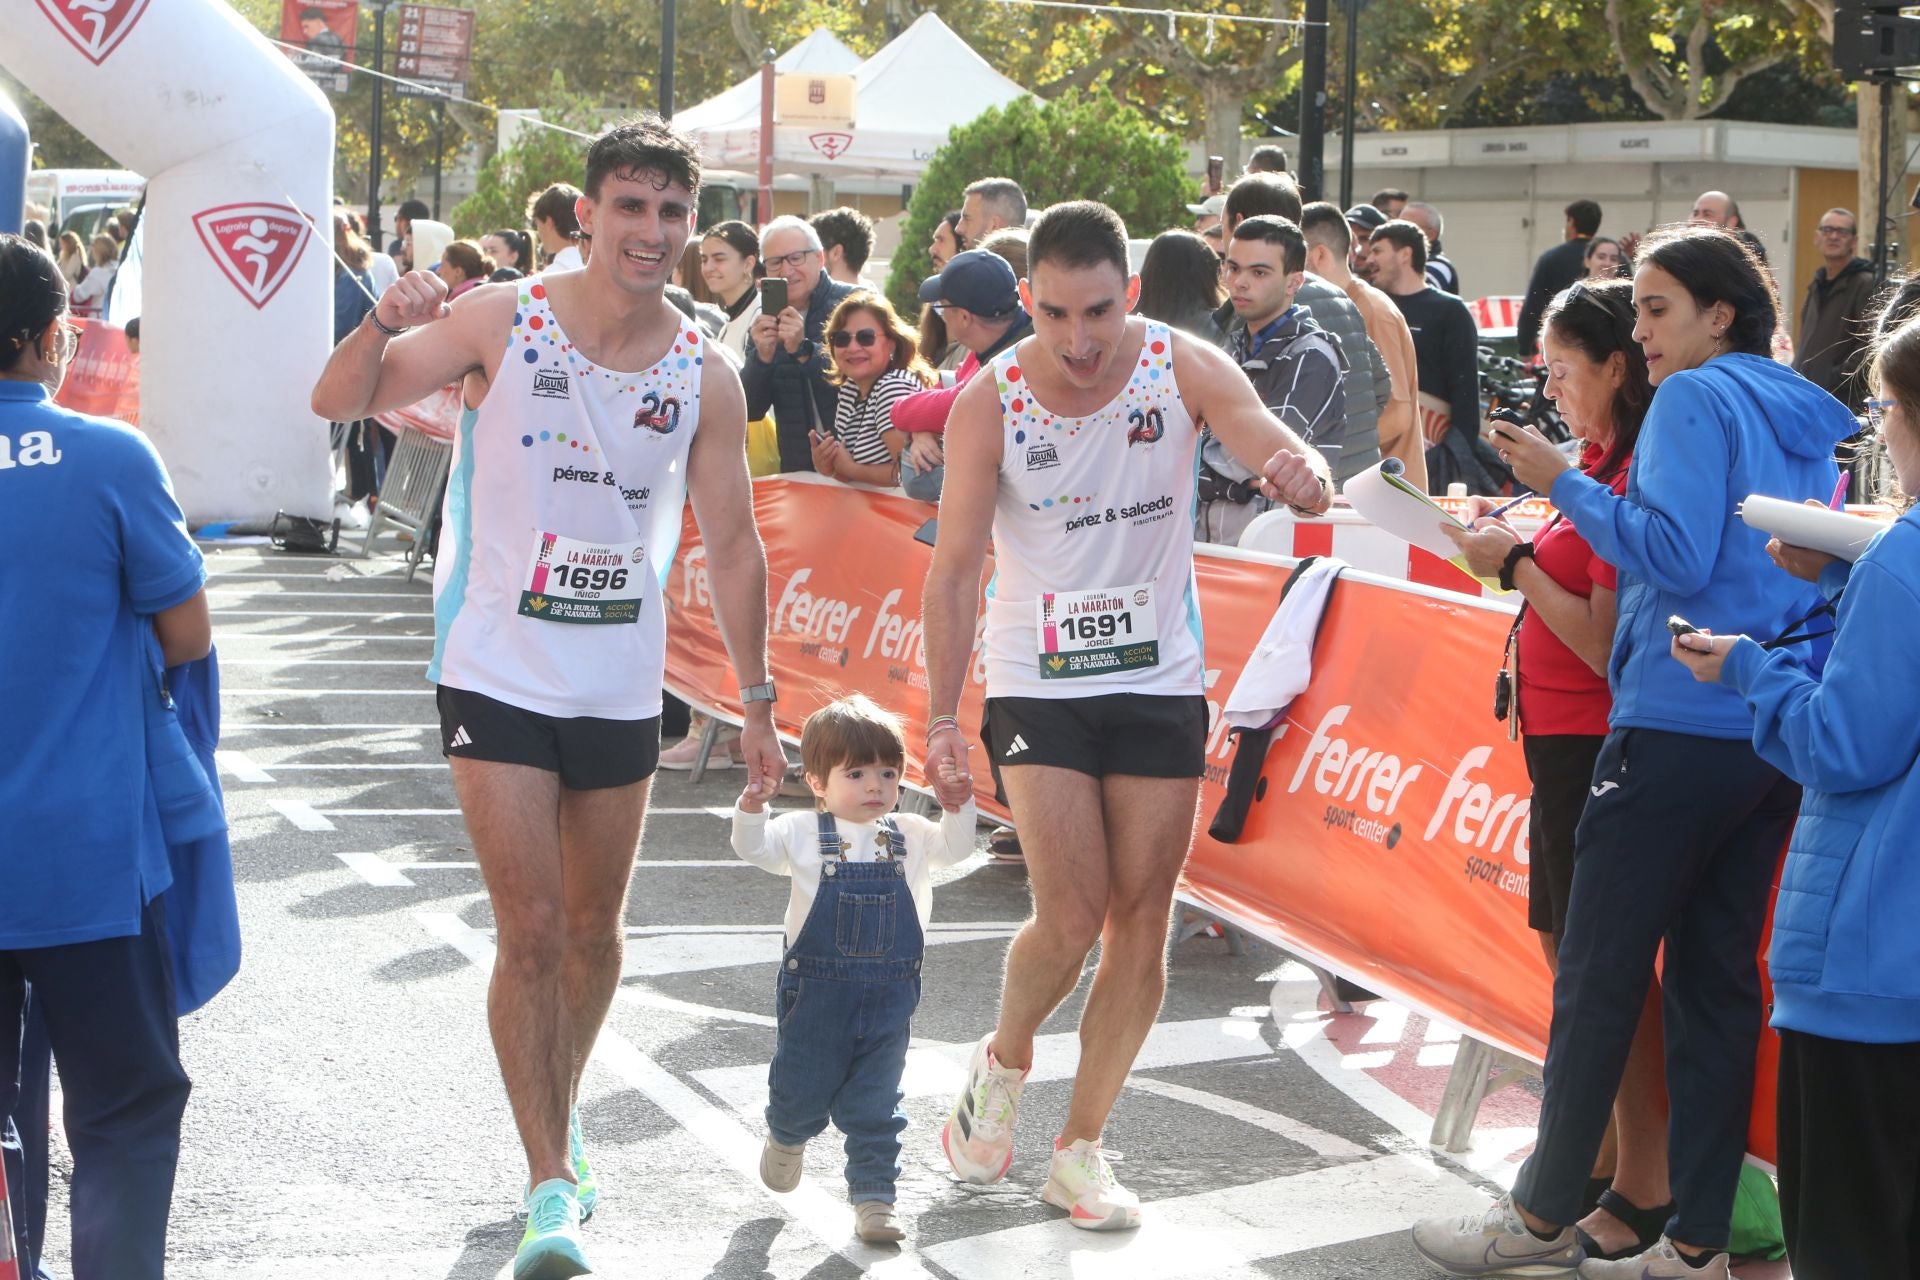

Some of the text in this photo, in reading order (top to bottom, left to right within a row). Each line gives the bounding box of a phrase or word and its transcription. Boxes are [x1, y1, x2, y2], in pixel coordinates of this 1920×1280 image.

[404, 7, 419, 19] 21
[402, 24, 418, 36] 22
[398, 57, 415, 69] 24
[216, 221, 298, 236] Logroño deporte
[533, 374, 569, 393] LAGUNA
[1026, 448, 1059, 465] LAGUNA
[553, 465, 599, 483] pérez
[602, 471, 616, 487] &
[1065, 495, 1173, 534] pérez & salcedo
[1133, 509, 1174, 527] FISIOTERAPIA
[536, 561, 550, 569] 21K
[567, 550, 579, 564] LA
[581, 553, 623, 567] MARATÓN
[553, 564, 629, 591] 1696
[574, 590, 601, 599] IÑIGO
[550, 608, 602, 618] DE NAVARRA
[551, 601, 600, 612] CAJA RURAL
[774, 568, 862, 644] ferrer
[1068, 602, 1080, 615] LA
[1082, 597, 1124, 613] MARATÓN
[1059, 611, 1132, 640] 1691
[1084, 638, 1114, 648] JORGE
[1069, 652, 1117, 664] CAJA RURAL
[1123, 646, 1152, 656] ACCIÓN
[1069, 659, 1122, 671] DE NAVARRA
[1288, 705, 1423, 816] ferrer
